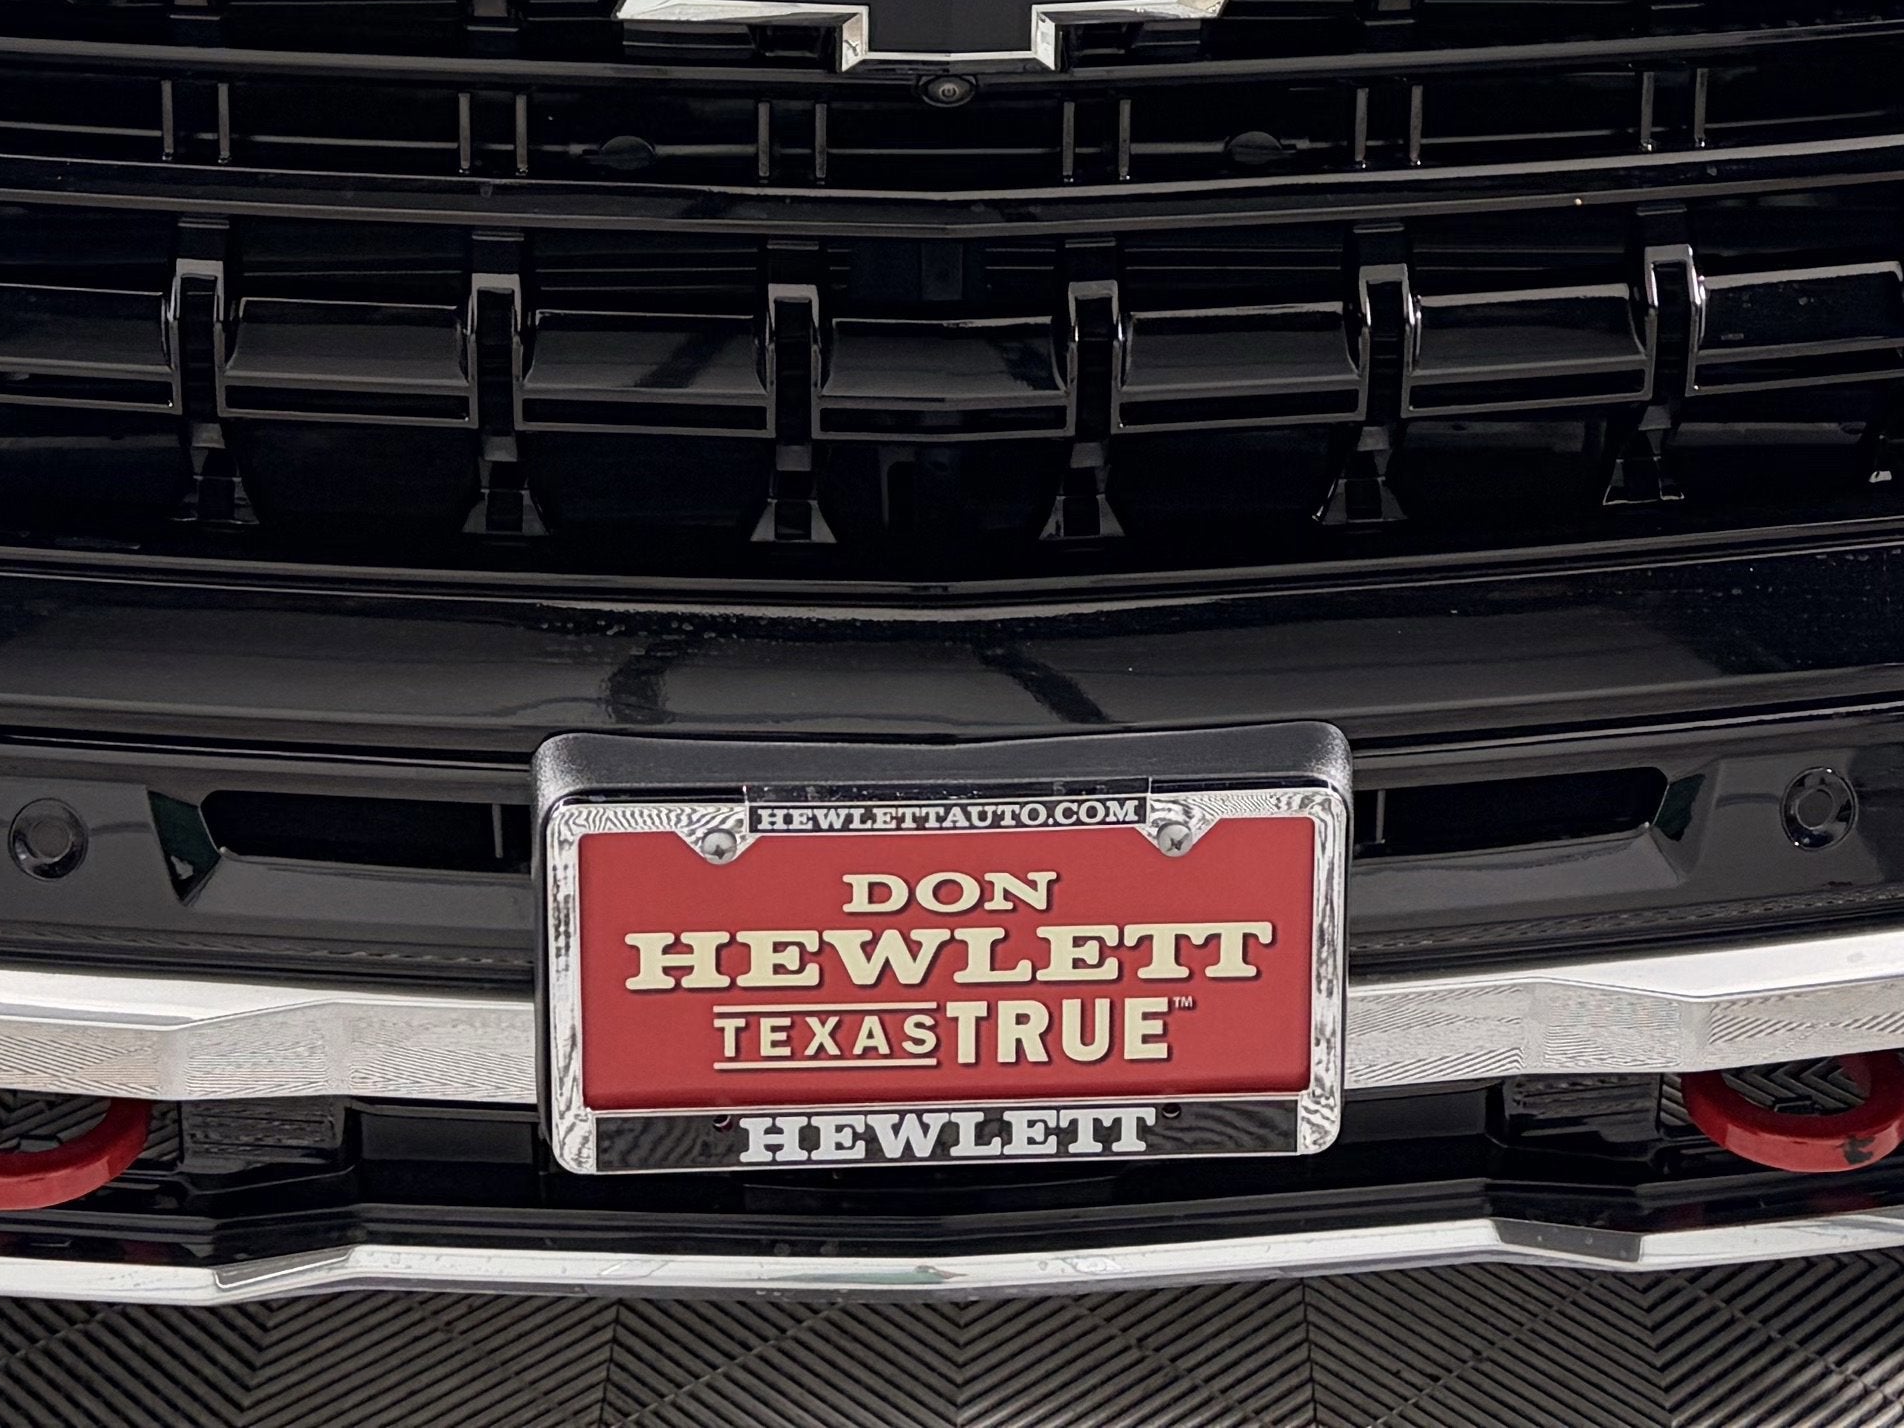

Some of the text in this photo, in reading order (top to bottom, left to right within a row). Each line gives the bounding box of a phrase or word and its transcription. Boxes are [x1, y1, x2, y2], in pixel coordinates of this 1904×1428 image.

[757, 800, 1140, 831] HEWLETTAUTO.COM
[842, 870, 1059, 914] DON
[624, 920, 1273, 990] HEWLETT
[714, 1013, 938, 1058] TEXAS
[946, 996, 1170, 1064] TRUE
[739, 1105, 1156, 1163] HEWLETT
